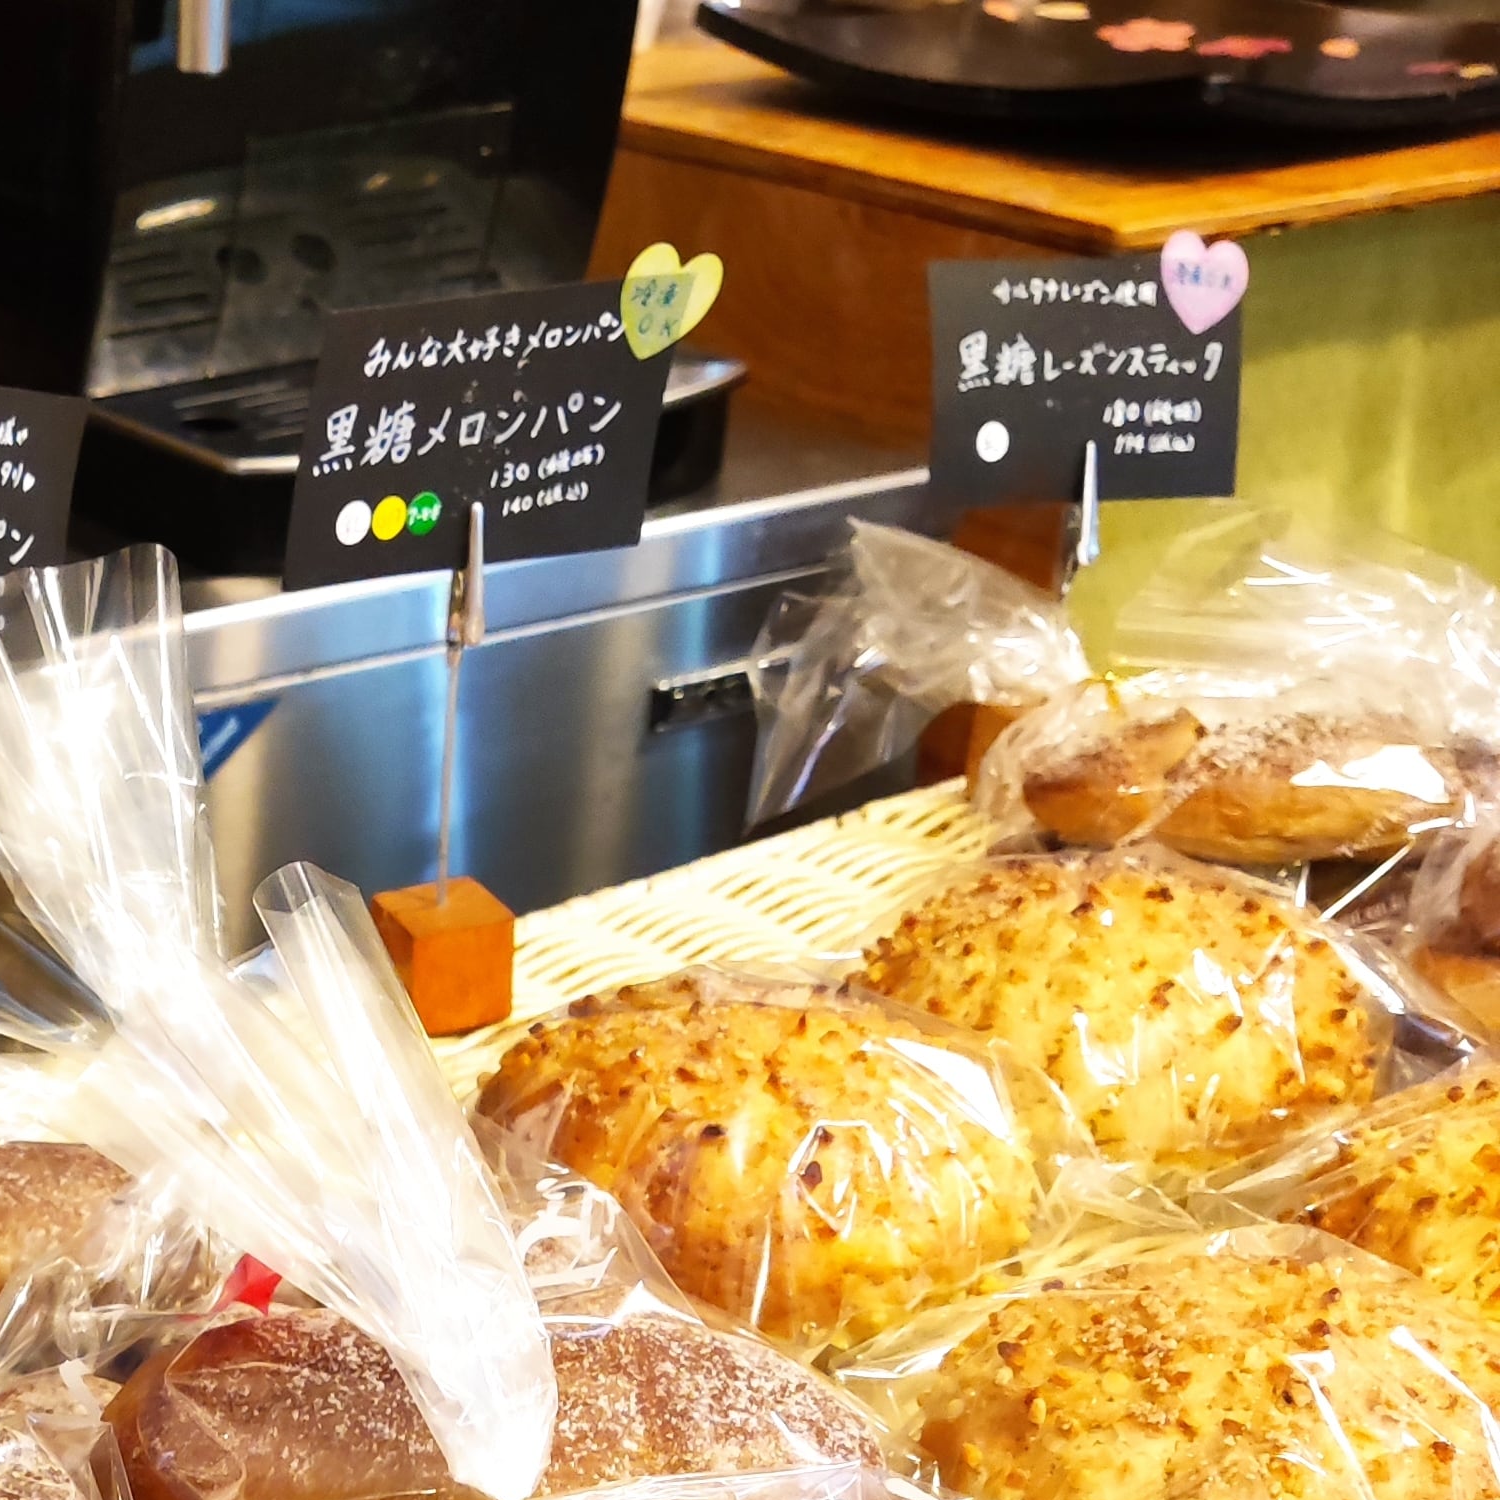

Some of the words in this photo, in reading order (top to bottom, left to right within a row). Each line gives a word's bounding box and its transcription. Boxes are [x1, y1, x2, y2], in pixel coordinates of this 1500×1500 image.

[363, 311, 627, 378] みんな大好きメロンパン
[311, 391, 622, 478] 黒糖メロンパン
[490, 461, 531, 489] 130
